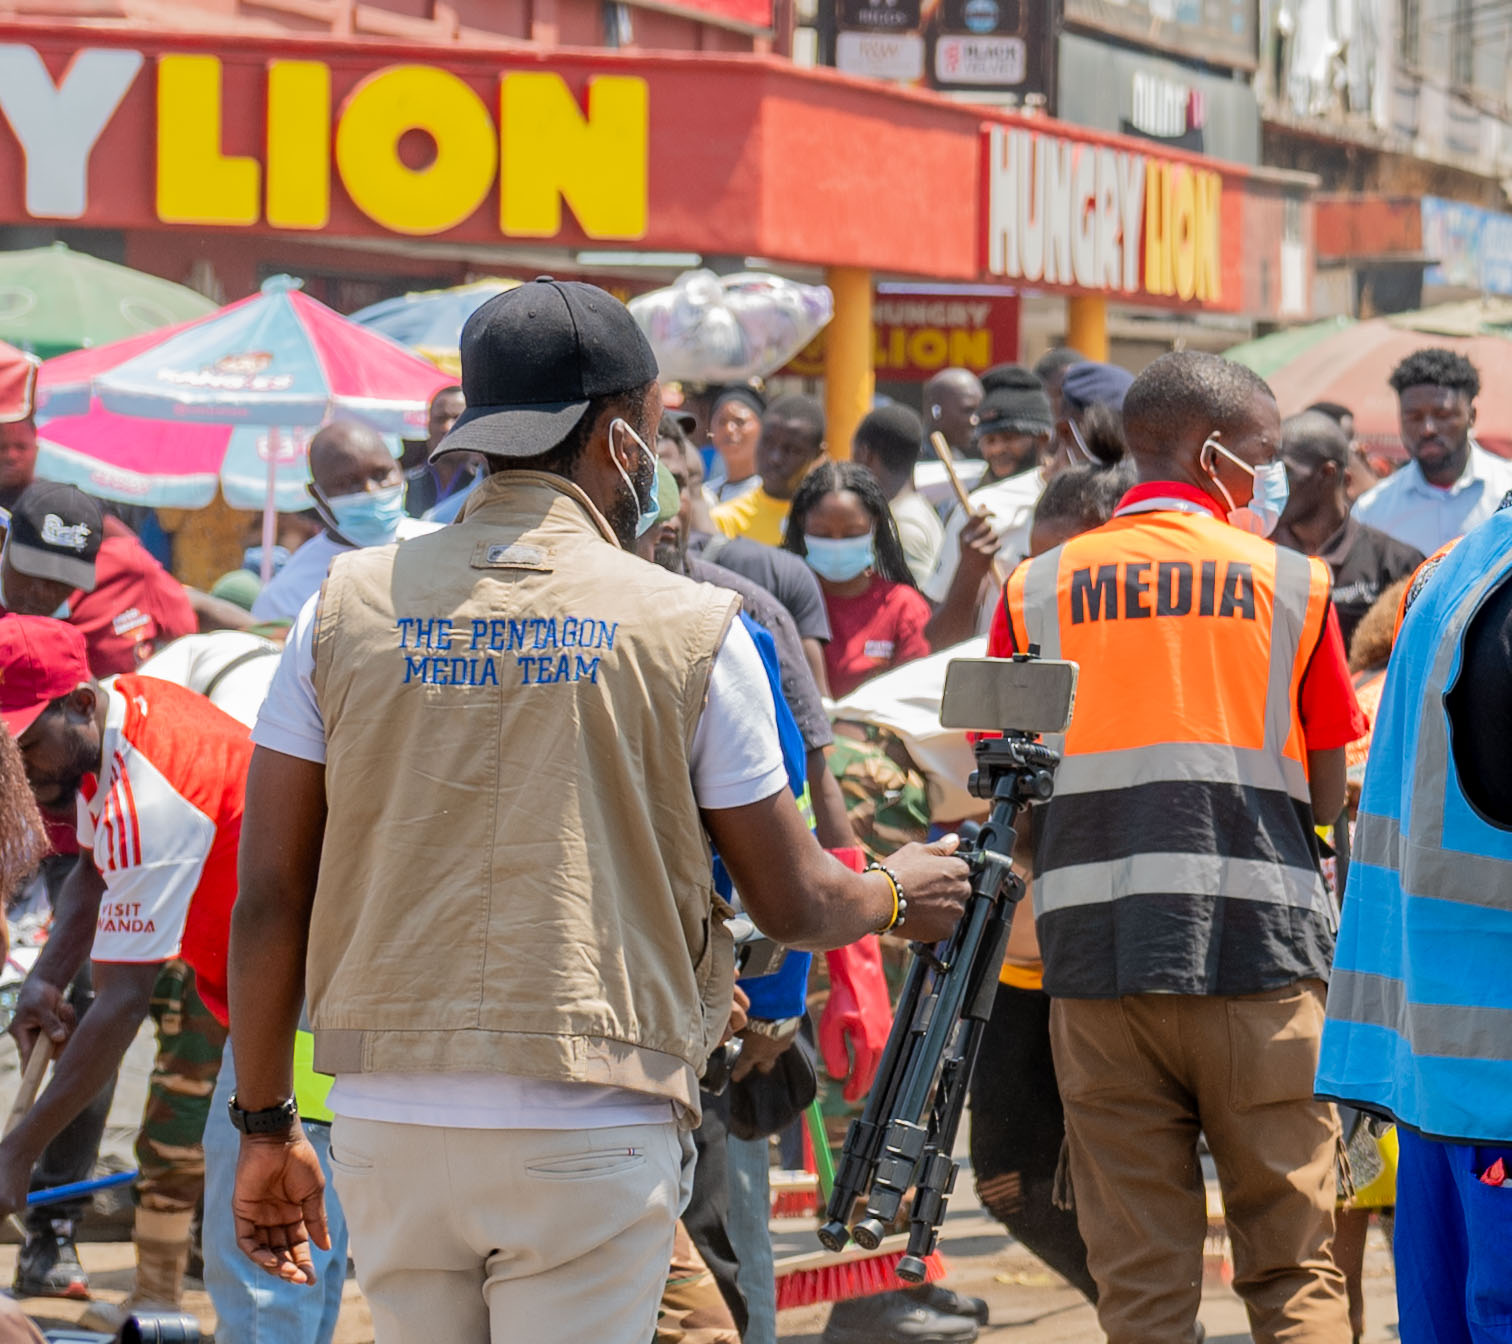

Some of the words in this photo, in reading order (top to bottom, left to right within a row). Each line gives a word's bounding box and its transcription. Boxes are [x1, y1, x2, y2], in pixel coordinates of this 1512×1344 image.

[157, 52, 649, 240] LION
[989, 124, 1146, 293] HUNGRY
[1144, 157, 1222, 303] LION
[1071, 560, 1256, 626] MEDIA
[397, 617, 453, 650] THE
[469, 616, 618, 651] PENTAGON
[403, 656, 499, 686] MEDIA
[517, 654, 601, 685] TEAM
